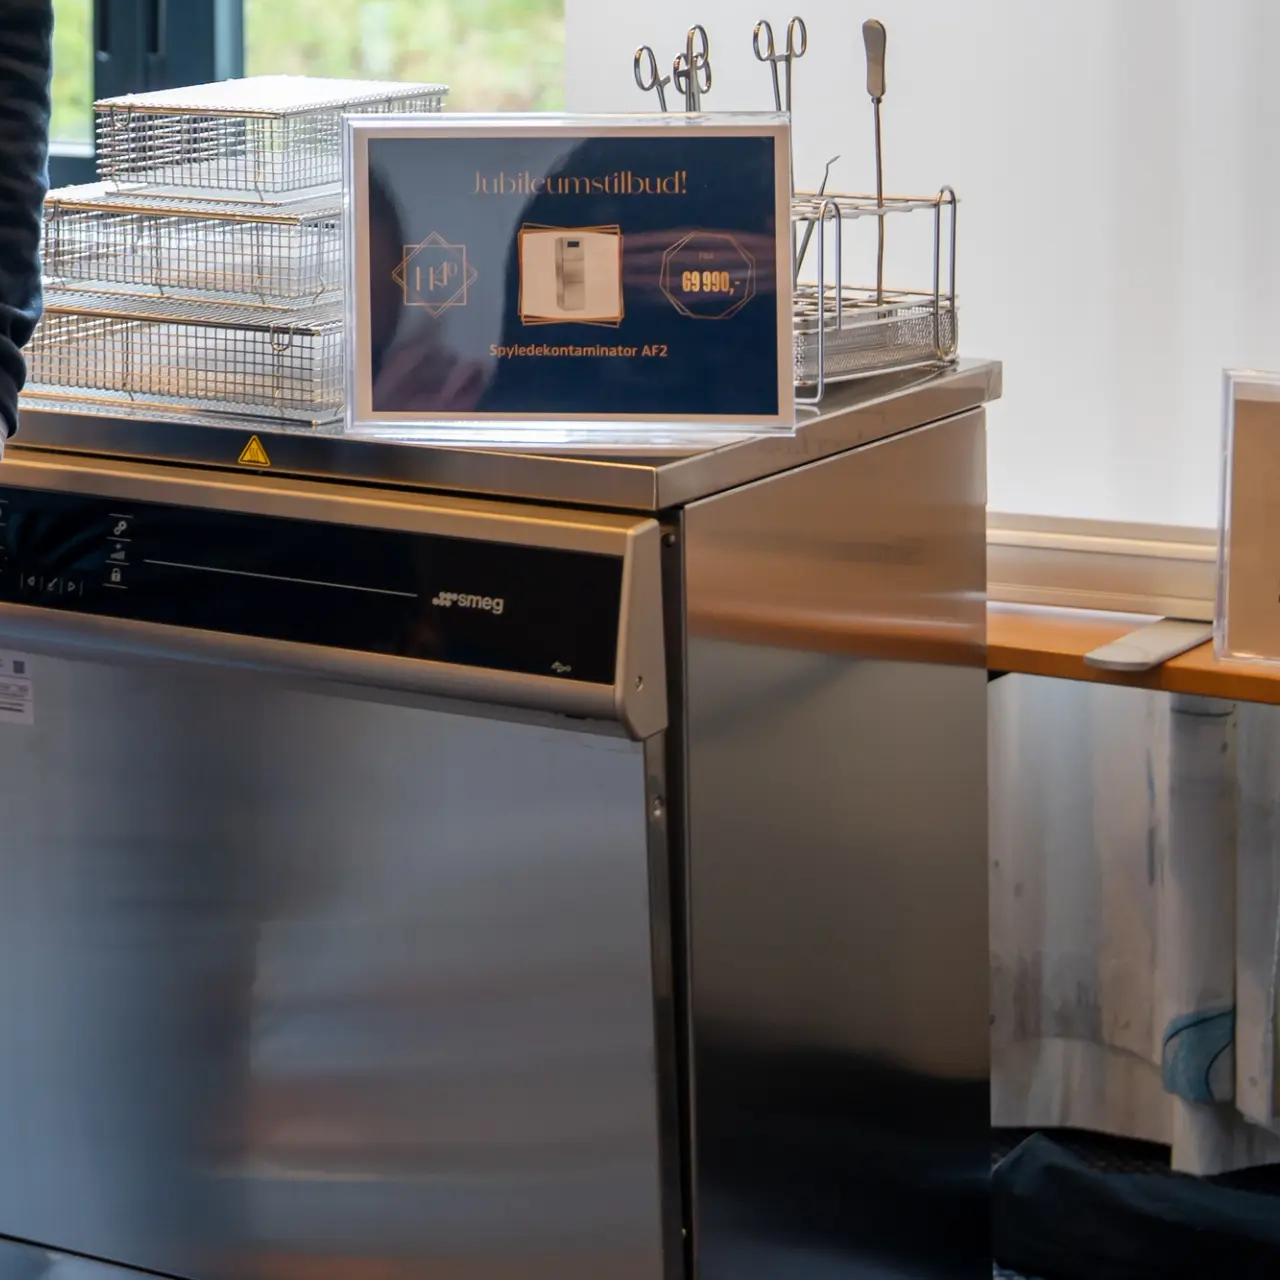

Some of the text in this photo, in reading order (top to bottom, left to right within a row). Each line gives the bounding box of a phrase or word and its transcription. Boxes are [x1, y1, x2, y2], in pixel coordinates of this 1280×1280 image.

[470, 170, 688, 194] Jubileumstilbud!
[682, 271, 700, 292] 69
[490, 343, 668, 359] Spyledekontaminator AF2
[457, 592, 505, 615] smeg
